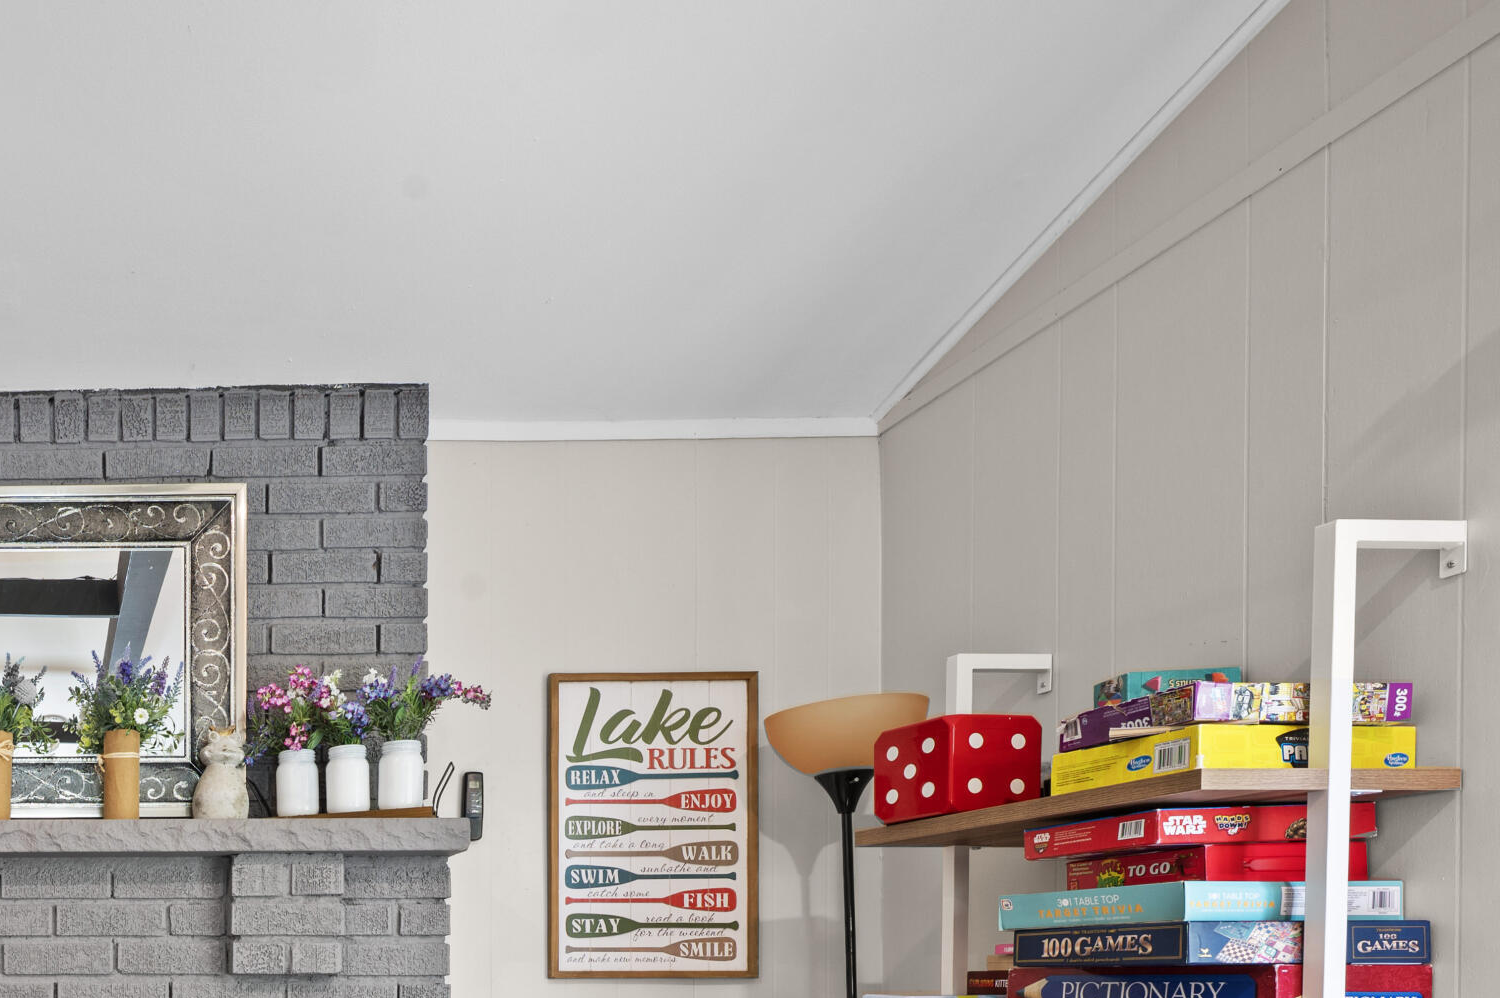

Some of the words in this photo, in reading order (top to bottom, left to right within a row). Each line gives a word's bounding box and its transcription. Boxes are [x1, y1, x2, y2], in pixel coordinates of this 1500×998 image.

[566, 687, 734, 763] Lake
[646, 747, 737, 770] RULES
[570, 769, 621, 785] RELAX
[584, 788, 605, 798] and
[610, 788, 640, 800] sleep
[680, 793, 733, 809] ENJOY
[637, 816, 667, 826] every
[671, 813, 715, 823] moment
[1168, 815, 1207, 826] STAR
[568, 820, 622, 835] EXPLORE
[1163, 825, 1206, 835] WARS
[573, 839, 594, 849] and
[600, 839, 624, 849] take
[640, 839, 665, 850] long
[681, 845, 733, 861] WALK
[640, 863, 692, 873] sunbathe
[695, 865, 718, 873] and
[1128, 864, 1146, 878] TO
[1149, 861, 1171, 875] GO
[570, 868, 620, 884] SWIM
[587, 887, 618, 898] catch
[623, 890, 650, 898] some
[1073, 895, 1100, 906] TABLE
[1100, 894, 1120, 904] TOP
[683, 893, 729, 908] FISH
[645, 913, 673, 922] read
[688, 913, 716, 922] book
[1037, 907, 1087, 919] TARGET
[1092, 904, 1145, 915] TRIVIA
[571, 918, 621, 934] STAY
[633, 927, 652, 942] for
[657, 928, 674, 937] the
[679, 927, 726, 937] weekend
[679, 942, 734, 957] SMILE
[1041, 937, 1073, 958] 100
[1074, 934, 1153, 957] GAMES
[1357, 940, 1420, 953] GAMES
[566, 954, 584, 963] and
[588, 954, 610, 963] make
[634, 956, 676, 964] memories
